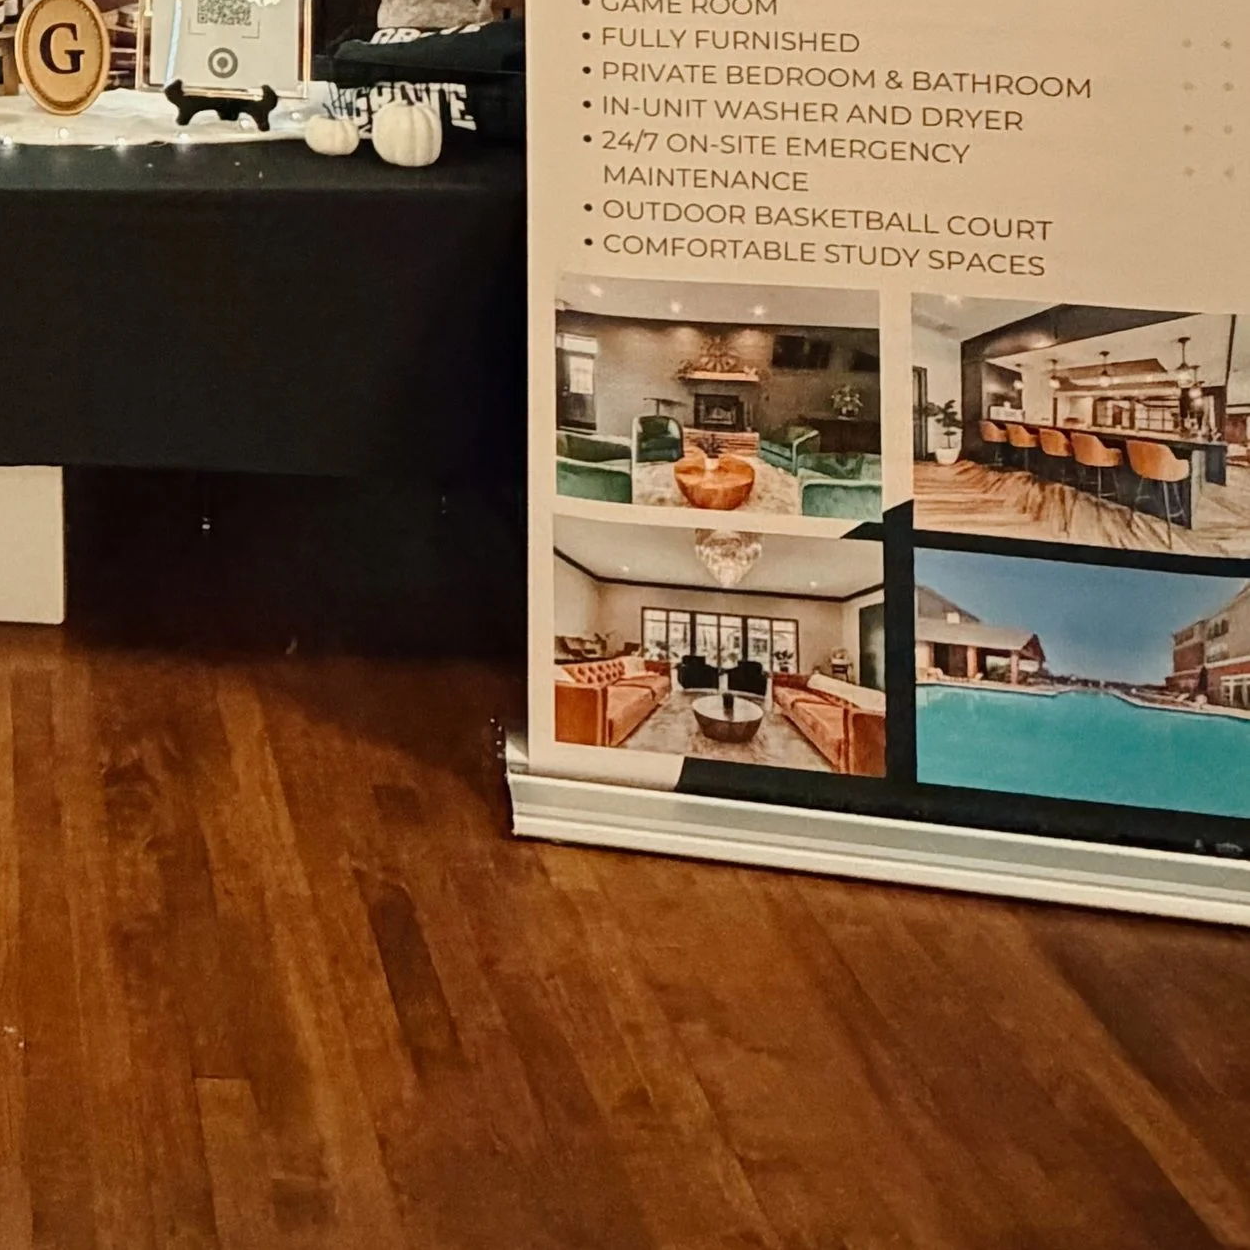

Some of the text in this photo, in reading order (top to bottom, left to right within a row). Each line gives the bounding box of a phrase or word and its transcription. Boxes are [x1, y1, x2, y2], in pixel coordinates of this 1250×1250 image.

[39, 22, 85, 75] G
[603, 27, 859, 52] FULLY FURNISHED
[603, 62, 1090, 98] PRIVATE BEDROOM & BATHROOM
[604, 96, 1022, 130] IN-UNIT WASHER AND DRYER
[602, 129, 970, 164] 24/7 ON-SITE EMERGENCY
[605, 165, 808, 191] MAINTENANCE
[603, 200, 1053, 240] OUTDOOR BASKETBALL COURT
[603, 234, 1045, 276] COMFORTABLE STUDY SPACES
